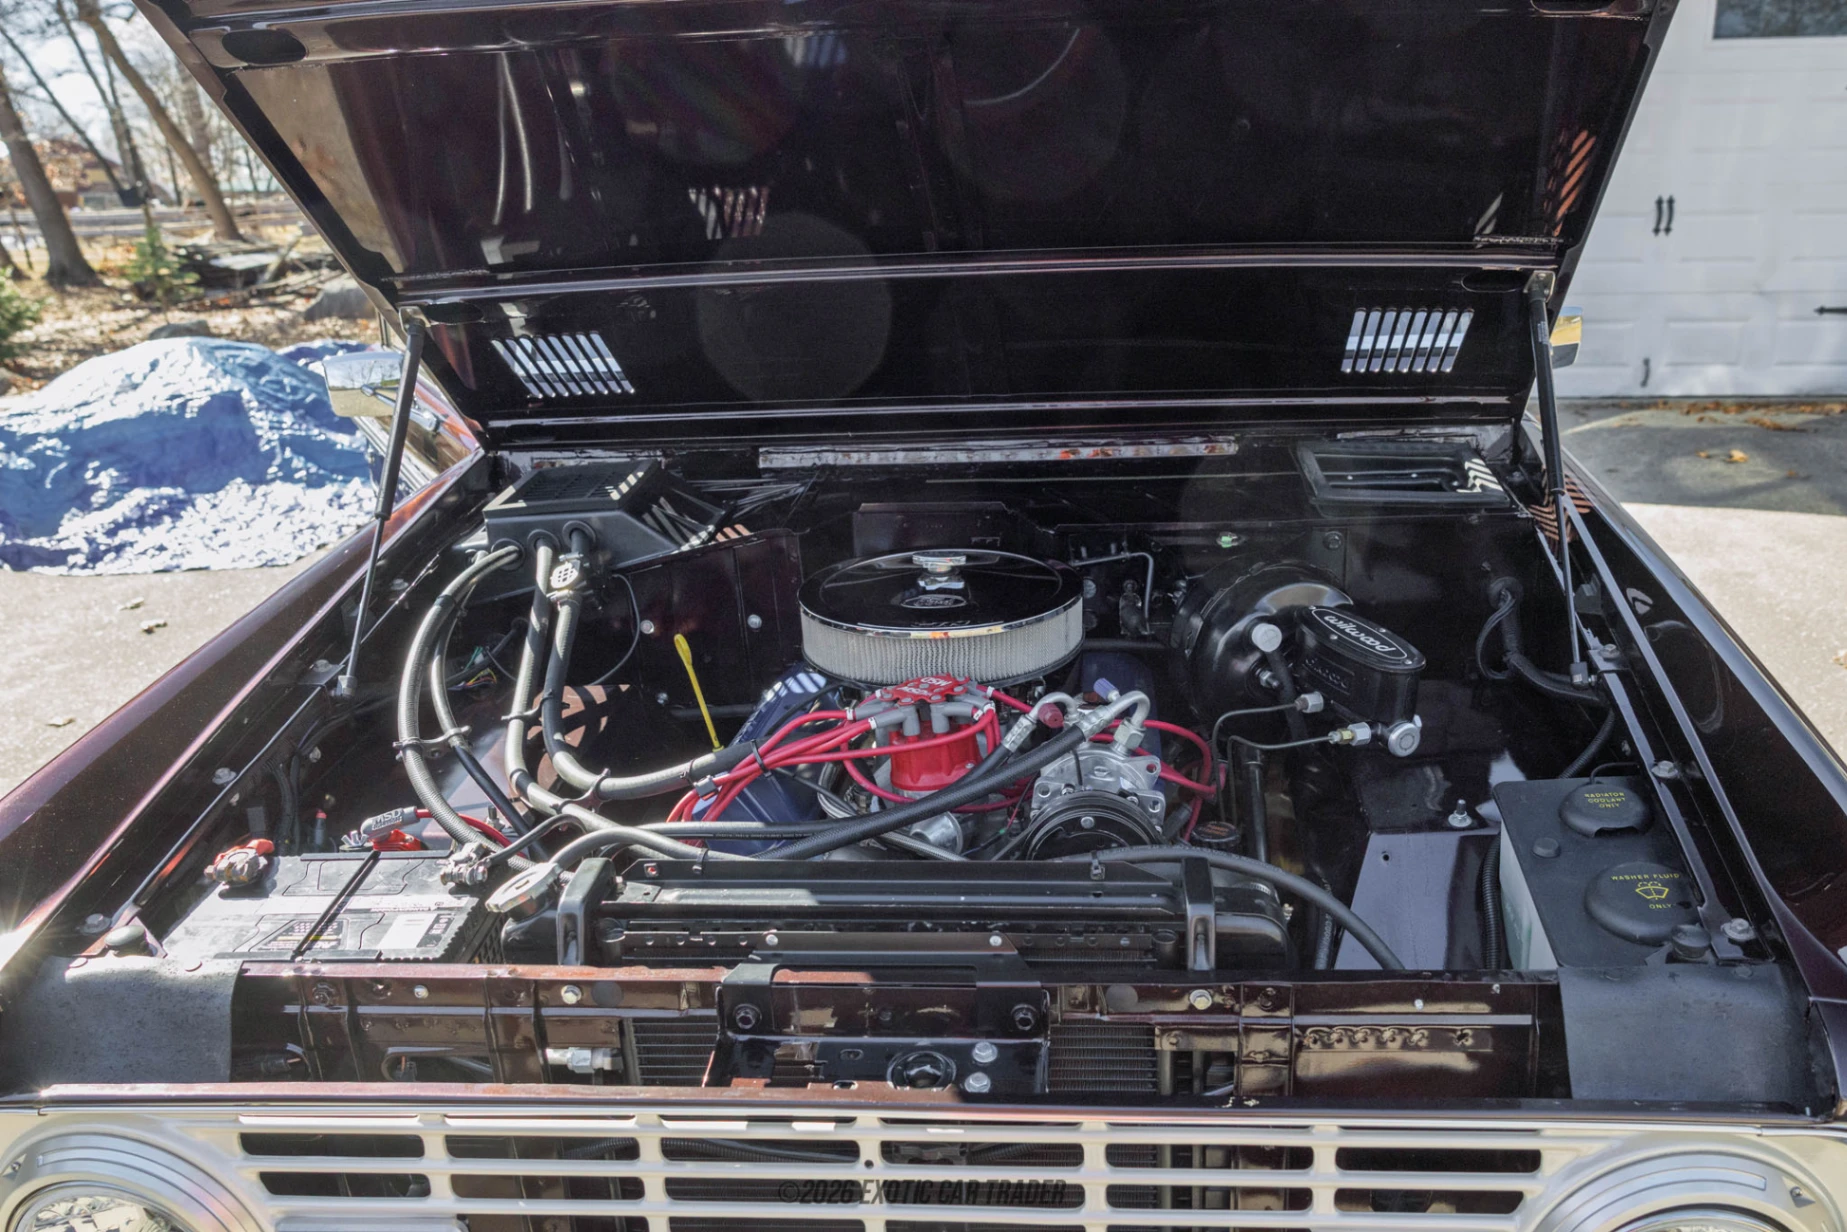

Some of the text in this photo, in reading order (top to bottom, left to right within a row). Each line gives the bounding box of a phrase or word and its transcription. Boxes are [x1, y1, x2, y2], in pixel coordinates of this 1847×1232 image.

[1323, 615, 1396, 652] wilwood
[374, 810, 402, 825] MSD
[1611, 873, 1650, 881] WASHER
